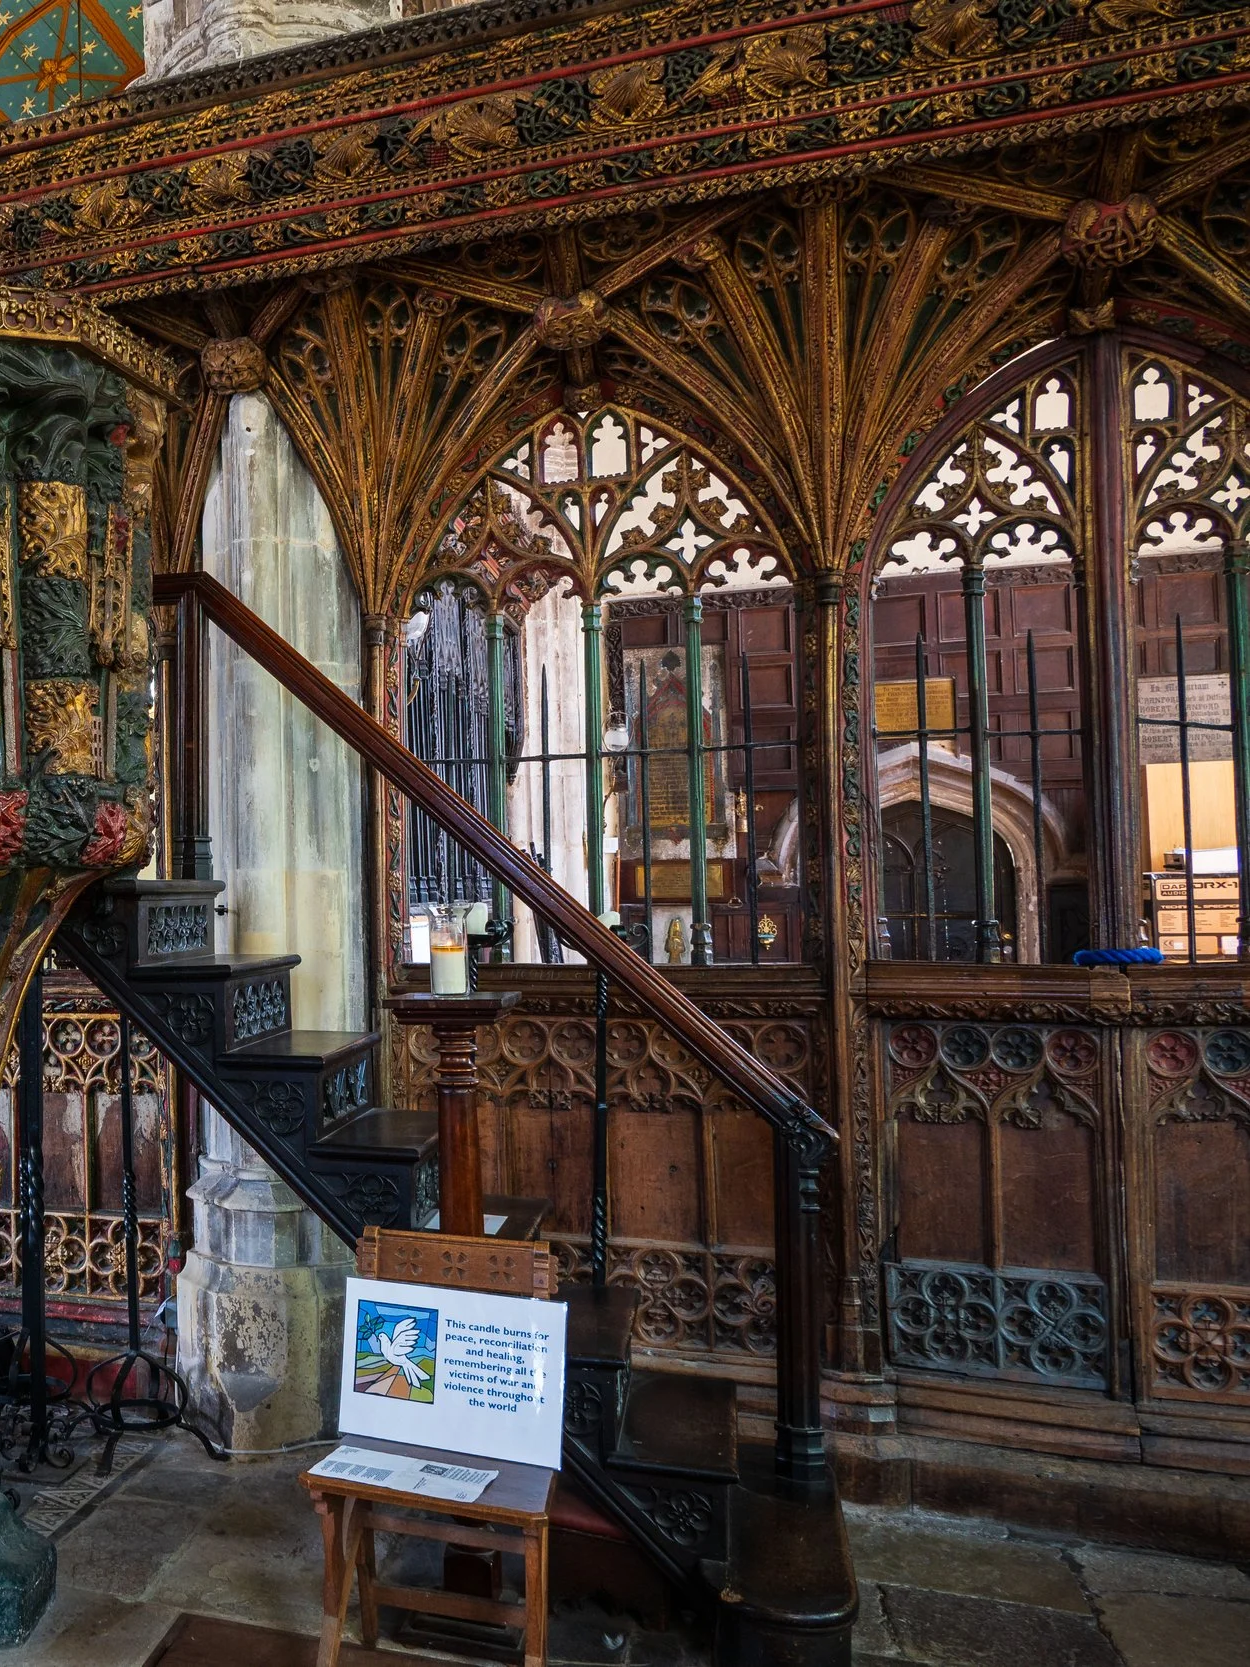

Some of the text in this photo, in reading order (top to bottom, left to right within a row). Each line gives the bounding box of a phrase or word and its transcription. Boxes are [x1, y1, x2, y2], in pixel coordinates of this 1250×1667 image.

[1165, 683, 1210, 692] Meoriam
[1139, 703, 1219, 713] ROBERT CANFORD
[1141, 735, 1173, 743] ROBERT
[445, 1319, 550, 1341] This candle burns for
[445, 1333, 548, 1354] peace, reconciliation
[465, 1348, 525, 1365] and healing,
[443, 1357, 547, 1379] remembering all te
[448, 1369, 540, 1391] victims of war an
[443, 1381, 545, 1404] violence throughot
[468, 1397, 518, 1413] the world
